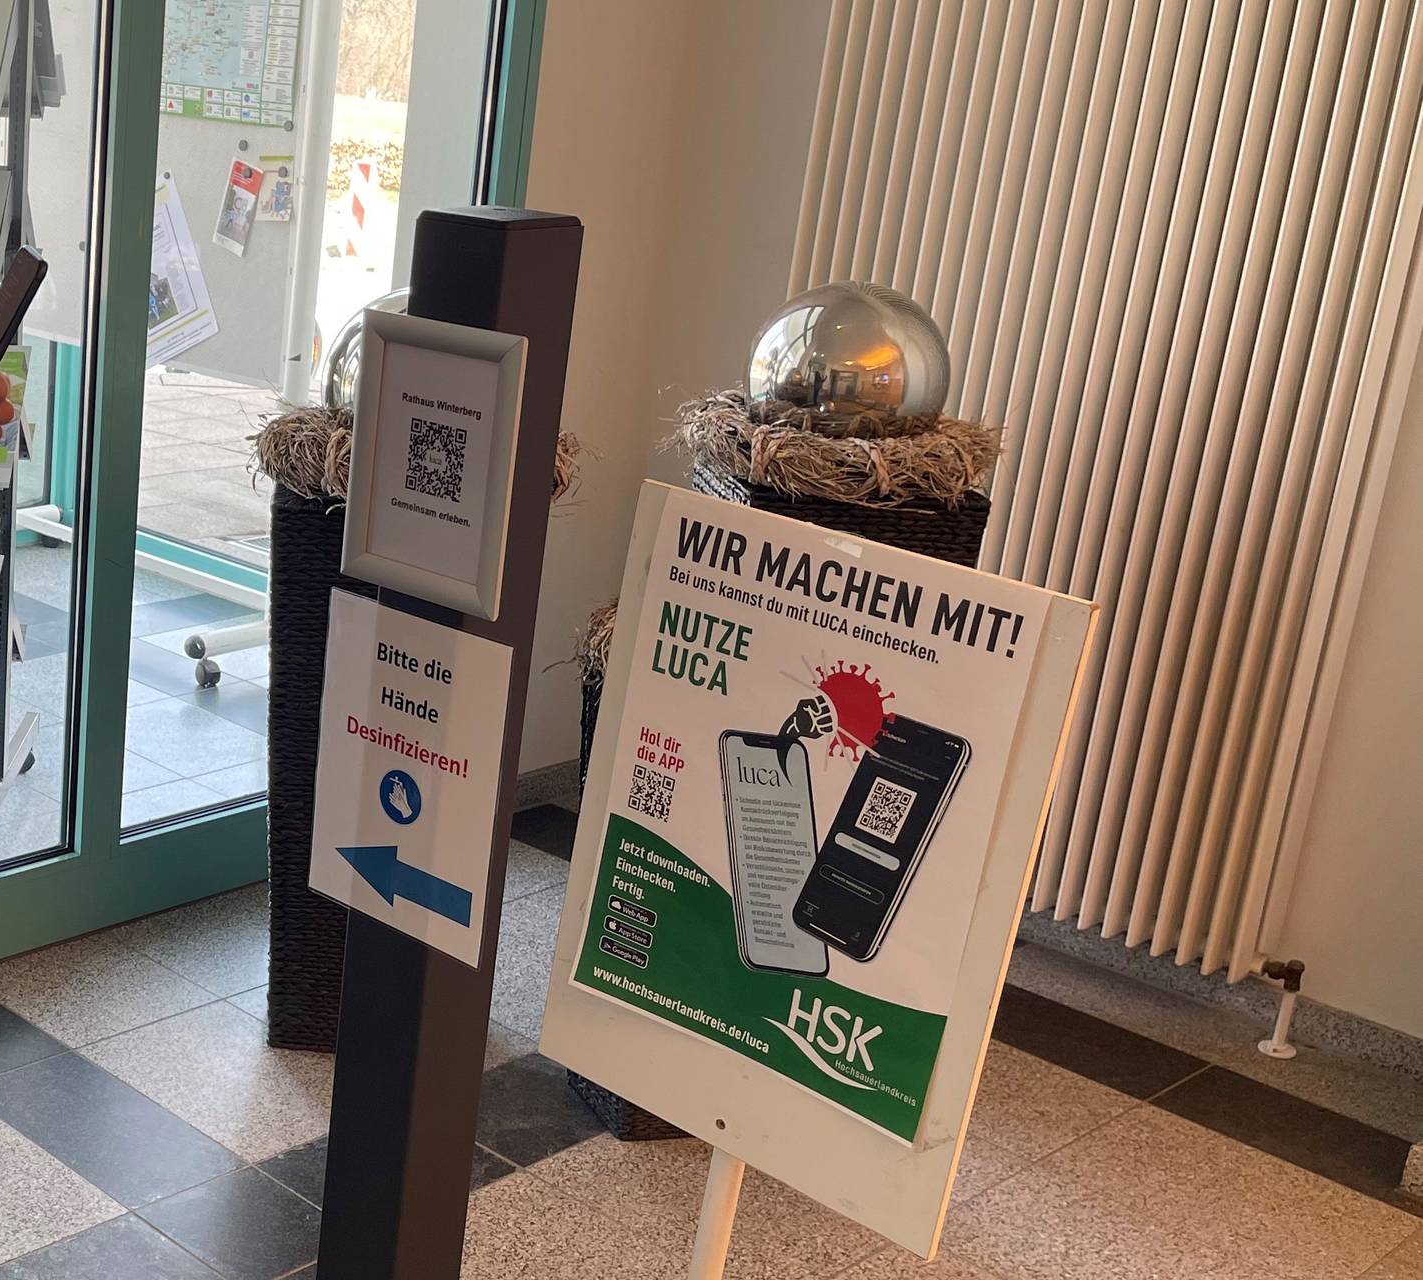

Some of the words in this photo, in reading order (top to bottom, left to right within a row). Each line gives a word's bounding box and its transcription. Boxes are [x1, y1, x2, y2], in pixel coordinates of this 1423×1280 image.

[402, 392, 435, 409] Rathaus
[437, 401, 482, 420] Winterberg
[391, 497, 437, 518] Gemeinsam
[439, 511, 471, 528] erleben.
[677, 516, 747, 577] WIR
[755, 541, 923, 628] MACHEN
[931, 592, 1024, 659] MIT!
[659, 600, 753, 661] NUTZE
[669, 565, 691, 585] Bei
[692, 575, 716, 593] uns
[719, 581, 764, 608] kannst
[766, 597, 783, 614] du
[786, 604, 809, 623] mit
[812, 609, 848, 635] LUCA
[852, 624, 939, 664] einchecken.
[377, 642, 419, 673] Bitte
[424, 659, 452, 684] die
[651, 639, 728, 696] LUCA
[381, 686, 439, 724] Hände
[347, 715, 469, 778] Desinfizieren!
[639, 726, 661, 747] Hol
[663, 736, 681, 753] dir
[637, 745, 655, 763] die
[658, 753, 685, 773] APP
[737, 756, 781, 787] luca
[615, 856, 676, 893] Einchecken.
[619, 838, 645, 859] Jetzt
[647, 850, 711, 888] downloaden.
[612, 875, 645, 900] Fertig.
[622, 906, 636, 917] Web
[636, 911, 649, 923] App
[618, 927, 631, 938] App
[631, 932, 648, 945] Store
[611, 945, 632, 960] Google
[632, 954, 645, 966] Play
[593, 965, 770, 1054] www.hochsauerlandkreis.de/luca
[787, 988, 883, 1072] HSK
[835, 1059, 917, 1108] Hochsauerlandkreis
